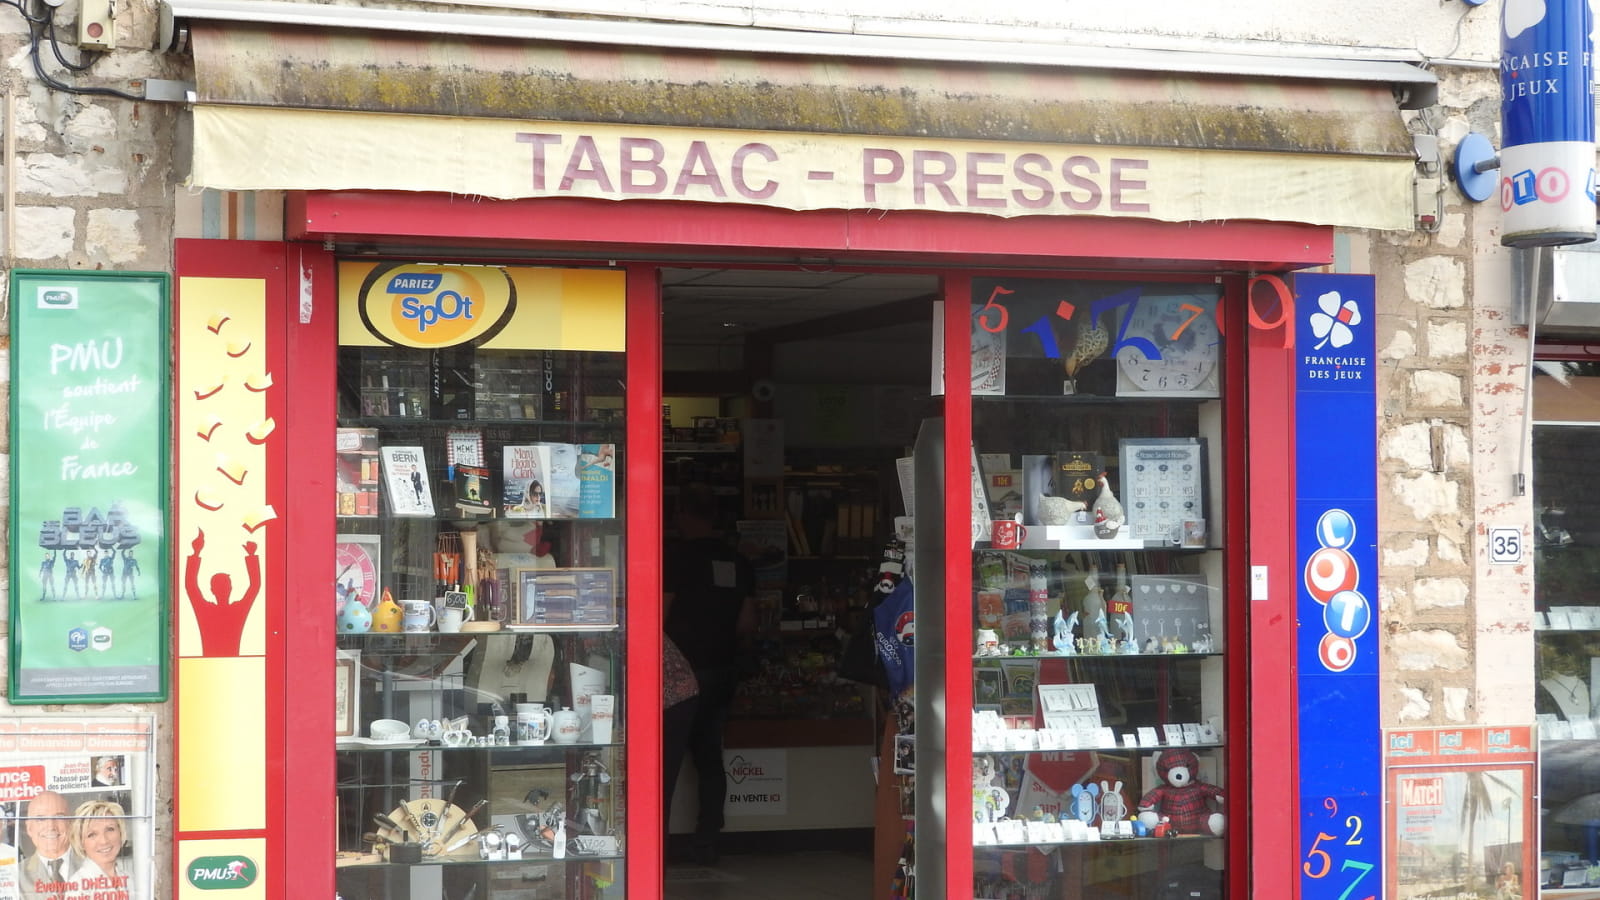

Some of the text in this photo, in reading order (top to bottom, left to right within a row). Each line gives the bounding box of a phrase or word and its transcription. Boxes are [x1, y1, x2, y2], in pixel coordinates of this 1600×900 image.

[1510, 79, 1558, 101] JEUX
[516, 132, 778, 199] TABAC
[863, 147, 1150, 213] PRESSE
[394, 279, 434, 289] PARIEZ
[979, 286, 1015, 333] 5
[1170, 303, 1204, 341] 7
[50, 336, 123, 376] PMU
[1305, 356, 1367, 369] FRANÇAISE
[63, 373, 141, 398] soutient
[1309, 370, 1362, 381] DES JEUX
[44, 401, 117, 434] l'Équipe
[80, 437, 99, 450] de
[391, 452, 418, 464] BERN
[513, 447, 535, 461] Mary
[61, 455, 138, 481] France
[512, 467, 537, 480] Clark
[1494, 536, 1518, 555] 35
[1306, 510, 1370, 671] LOTO
[1114, 602, 1128, 613] 10€
[53, 775, 90, 785] Tabassé par
[733, 767, 764, 777] NICKEL
[729, 793, 781, 802] EN VENTE ICI
[1402, 778, 1443, 806] MATCH
[1323, 797, 1338, 819] 9
[1345, 815, 1363, 846] 2
[1303, 832, 1337, 879] 5
[193, 868, 228, 880] PMU
[1338, 859, 1375, 900] 7
[35, 878, 79, 893] Évelyne
